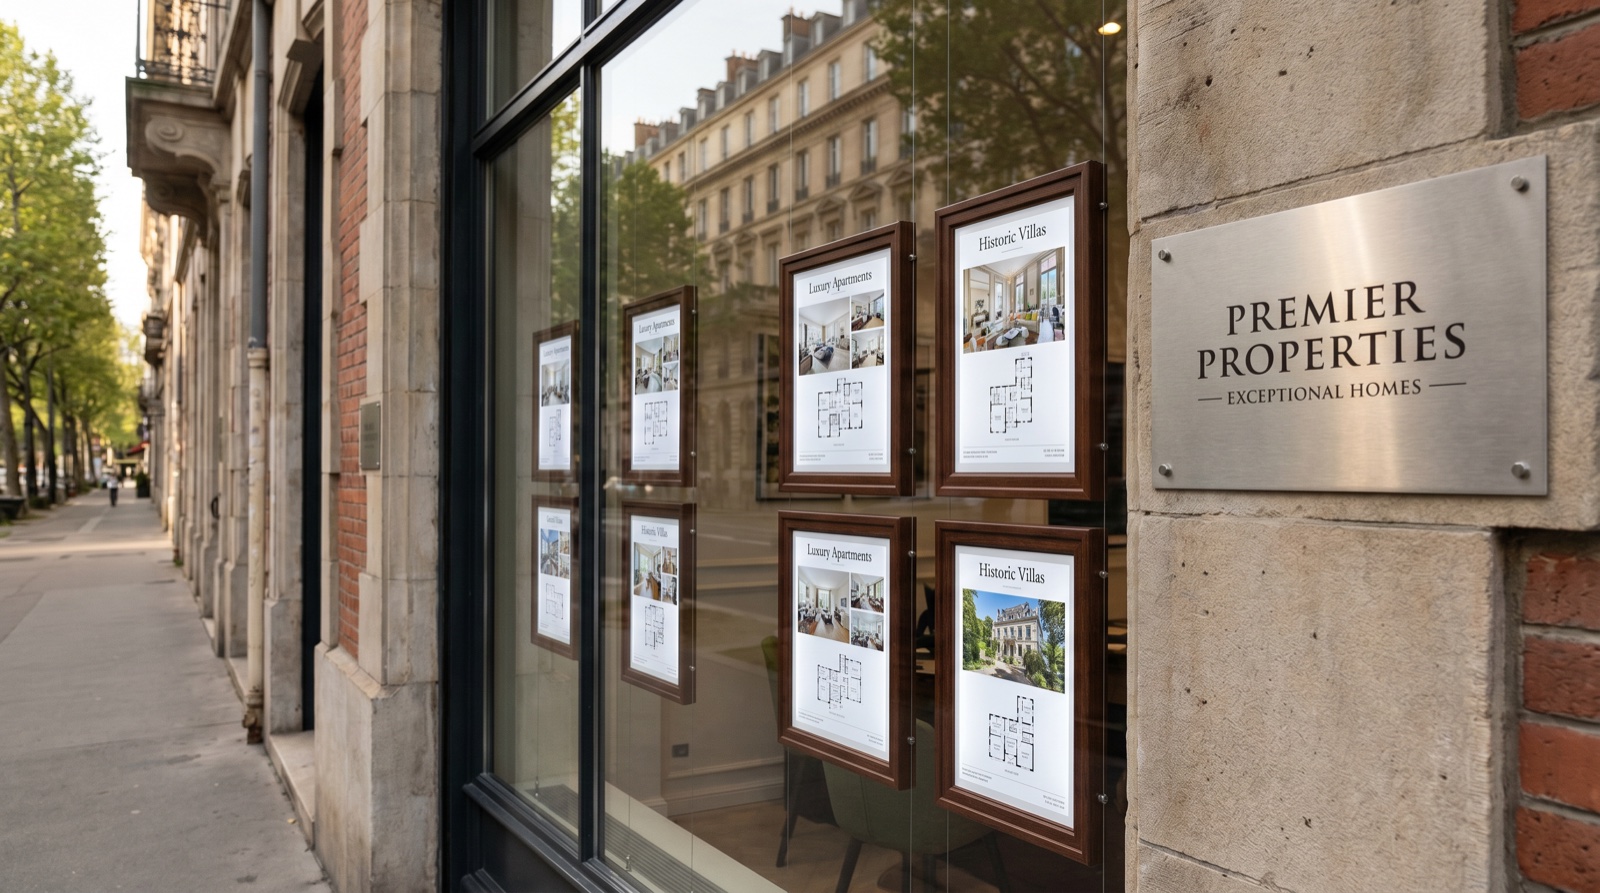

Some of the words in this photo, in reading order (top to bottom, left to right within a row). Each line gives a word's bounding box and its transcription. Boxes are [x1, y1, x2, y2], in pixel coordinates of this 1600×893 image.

[979, 230, 1016, 251] Historic
[1018, 223, 1047, 241] Villas
[809, 282, 832, 294] Luxury
[832, 271, 873, 291] Apartments
[1226, 280, 1426, 336] PREMIER
[1197, 322, 1466, 380] PROPERTIES
[1227, 384, 1344, 405] EXCEPTIONAL
[1350, 378, 1422, 398] HOMES
[807, 543, 831, 560] Luxury
[831, 546, 873, 562] Apartments
[979, 562, 1016, 581] Historic
[1018, 566, 1045, 584] Villas
